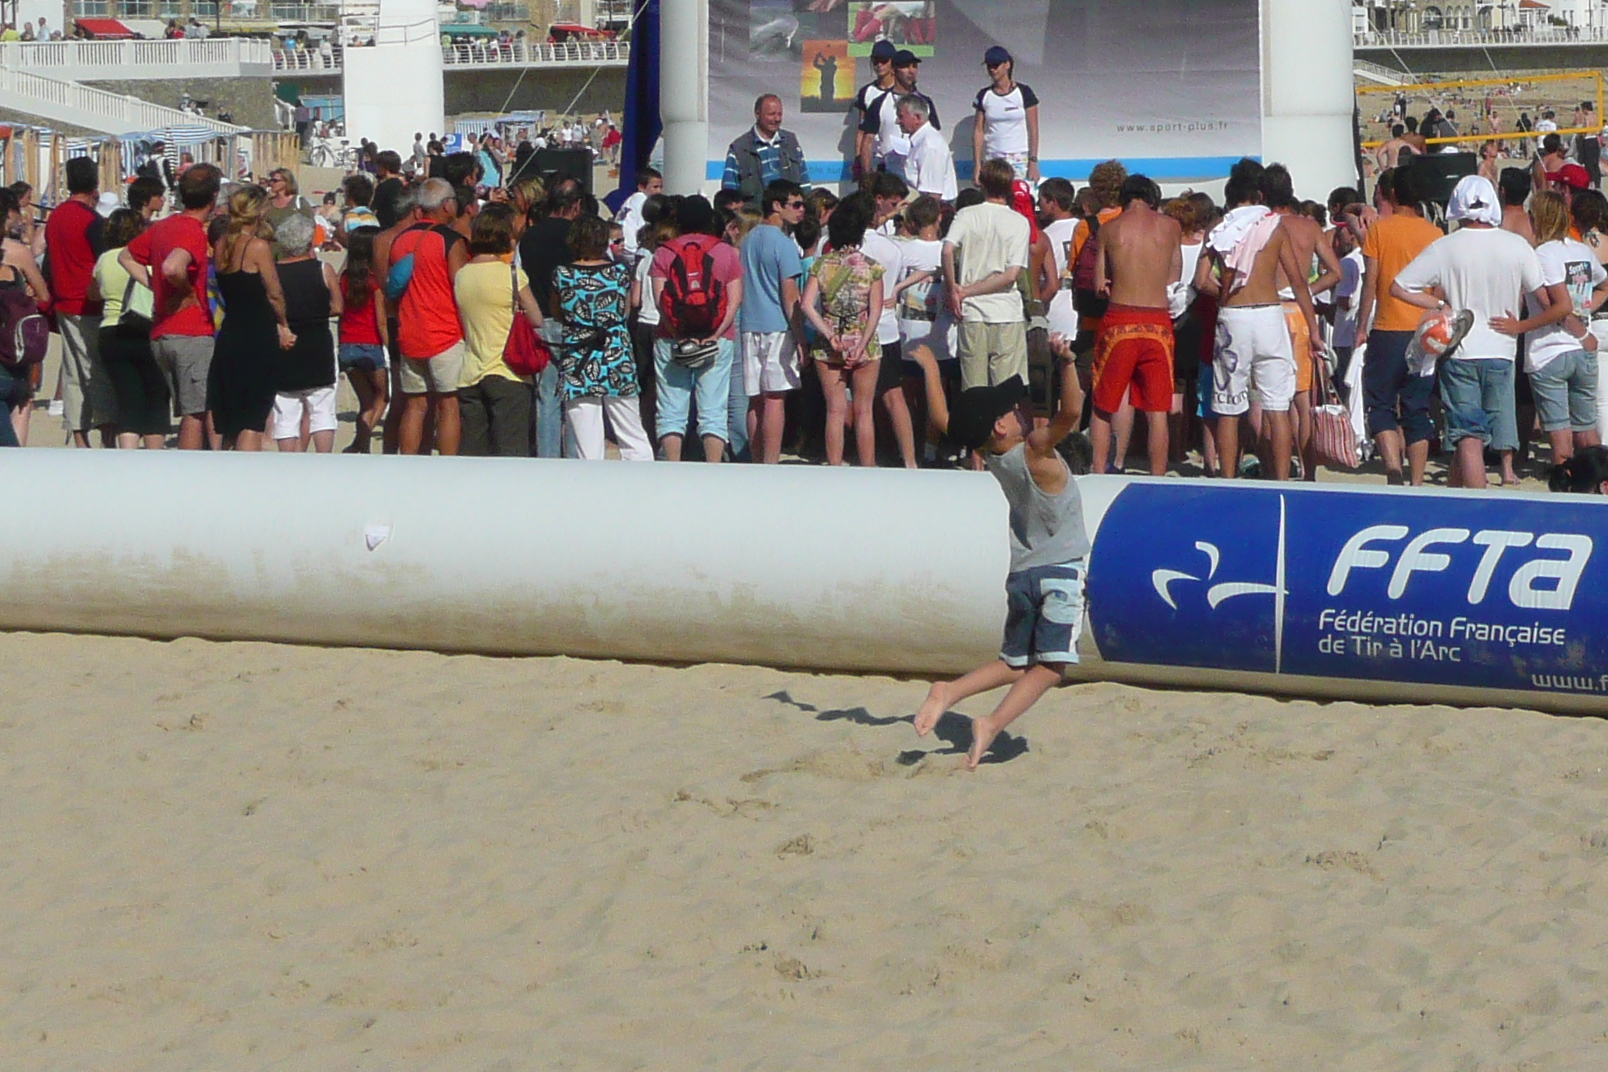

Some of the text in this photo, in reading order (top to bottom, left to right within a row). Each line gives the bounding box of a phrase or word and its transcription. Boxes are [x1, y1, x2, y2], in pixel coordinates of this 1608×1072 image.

[1116, 121, 1229, 134] www.sport-plus.fr
[1318, 609, 1566, 648] Fédération Française
[1318, 635, 1462, 663] de Tir à l'Arc
